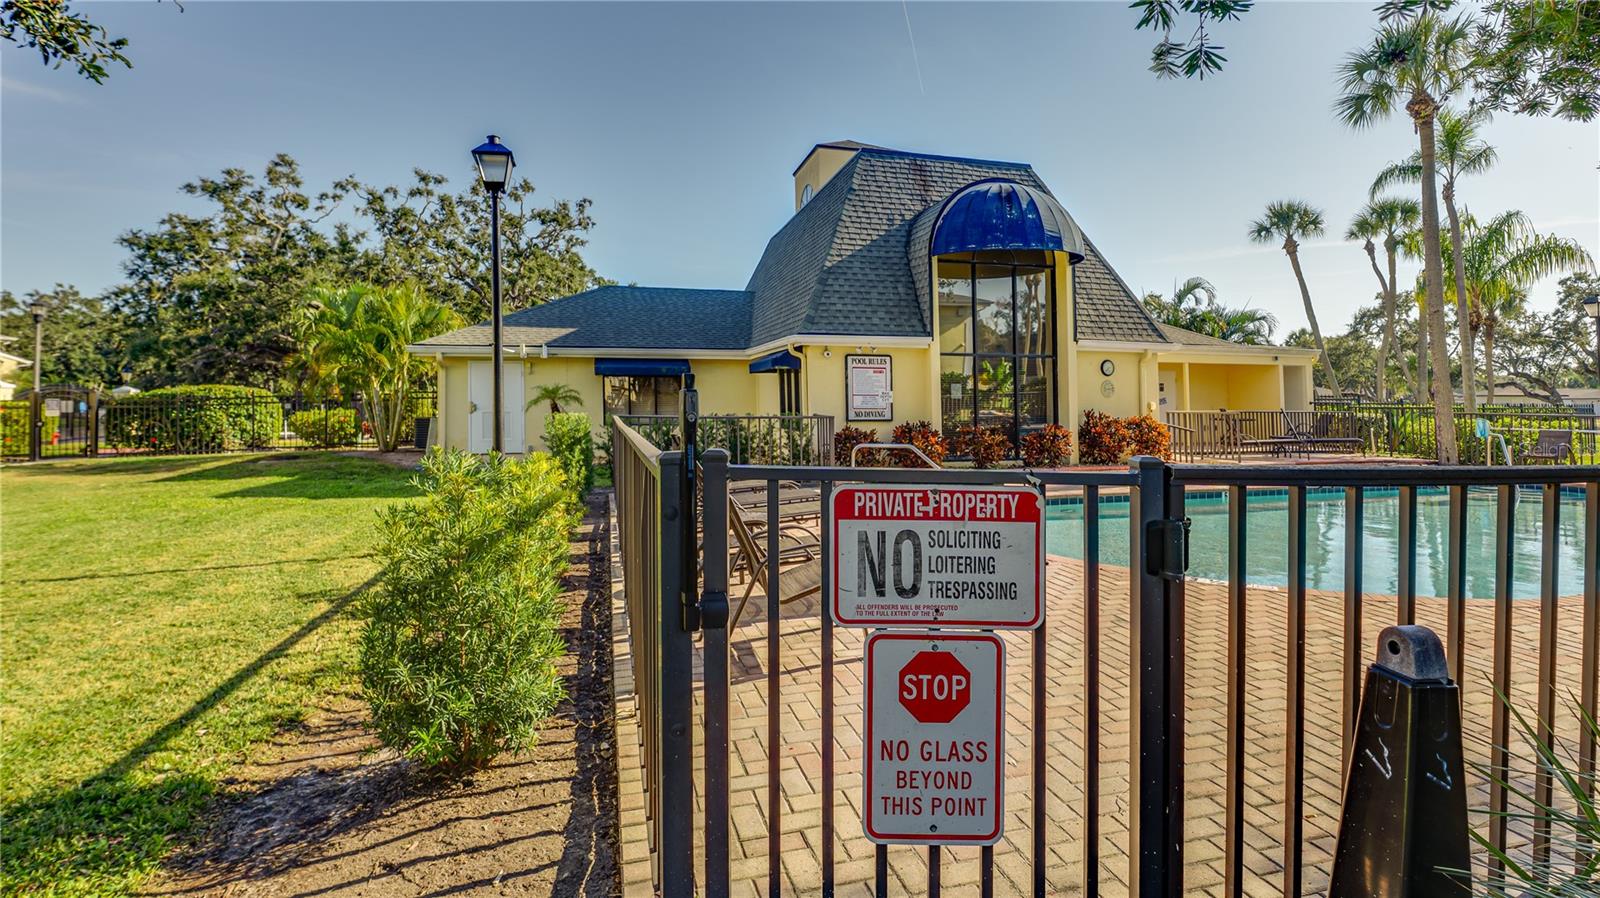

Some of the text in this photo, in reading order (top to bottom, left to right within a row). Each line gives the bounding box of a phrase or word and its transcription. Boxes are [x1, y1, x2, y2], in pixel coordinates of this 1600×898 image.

[854, 491, 1020, 519] PRIVATE PROPERTY
[928, 529, 1001, 550] SOLICITING
[857, 529, 923, 600] NO
[928, 555, 996, 575] LOITERING
[928, 580, 1018, 601] TRESPASSING
[902, 673, 967, 701] STOP
[880, 740, 989, 763] NO GLASS
[896, 770, 972, 790] BEYOND
[881, 796, 987, 817] THIS POINT
